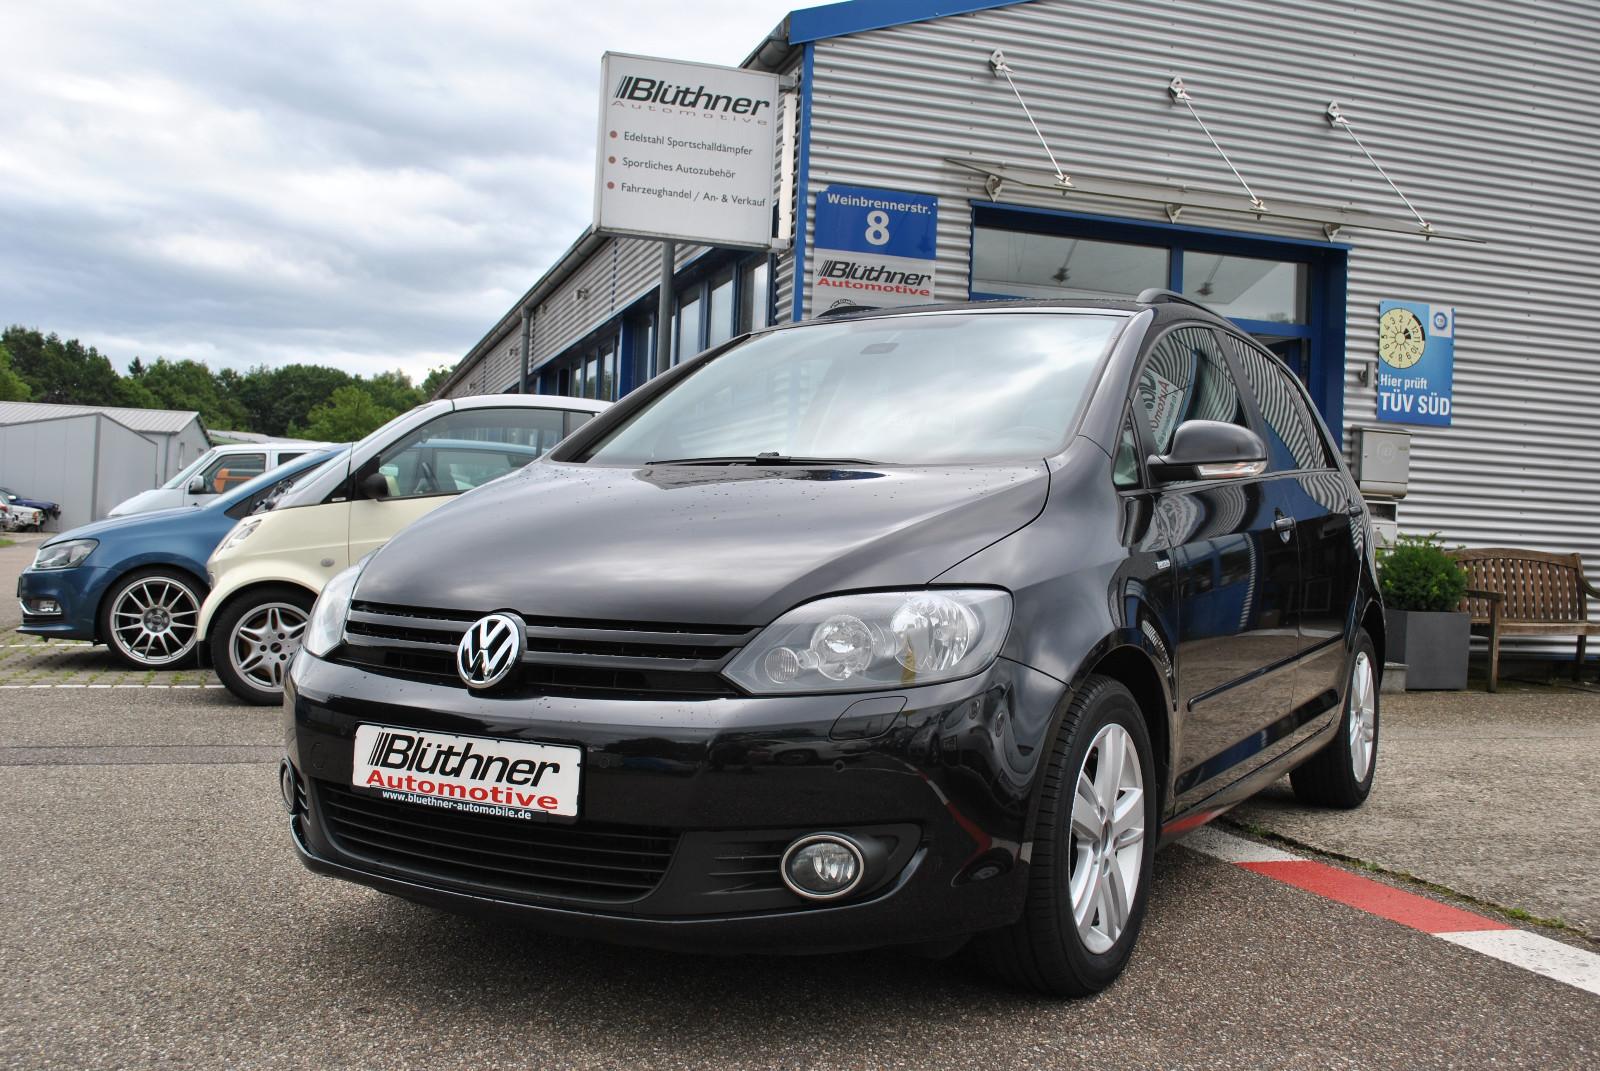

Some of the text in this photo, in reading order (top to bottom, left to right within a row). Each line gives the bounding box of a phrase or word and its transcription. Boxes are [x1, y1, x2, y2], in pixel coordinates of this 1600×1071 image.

[626, 77, 770, 116] Blüthner
[611, 101, 768, 126] Automotive
[624, 131, 753, 156] Edelstahl Sportschalldämpfer
[622, 157, 736, 179] Sportliches Autozubehör
[621, 182, 692, 199] Fahrzeughandel
[702, 192, 719, 202] An-
[721, 193, 728, 203] &
[731, 195, 766, 207] Verkauf
[827, 193, 931, 215] Weinbrennerstr.
[865, 210, 890, 246] 8
[825, 260, 932, 286] Blüthner
[817, 276, 930, 297] Automotive
[1380, 373, 1428, 391] Hier prüft
[1379, 388, 1451, 416] TÜV SÜD
[458, 613, 521, 689] VW
[378, 732, 561, 788] Blüthner
[366, 769, 559, 810] Automotive
[382, 789, 532, 820] www.bluethner-automobile.de
